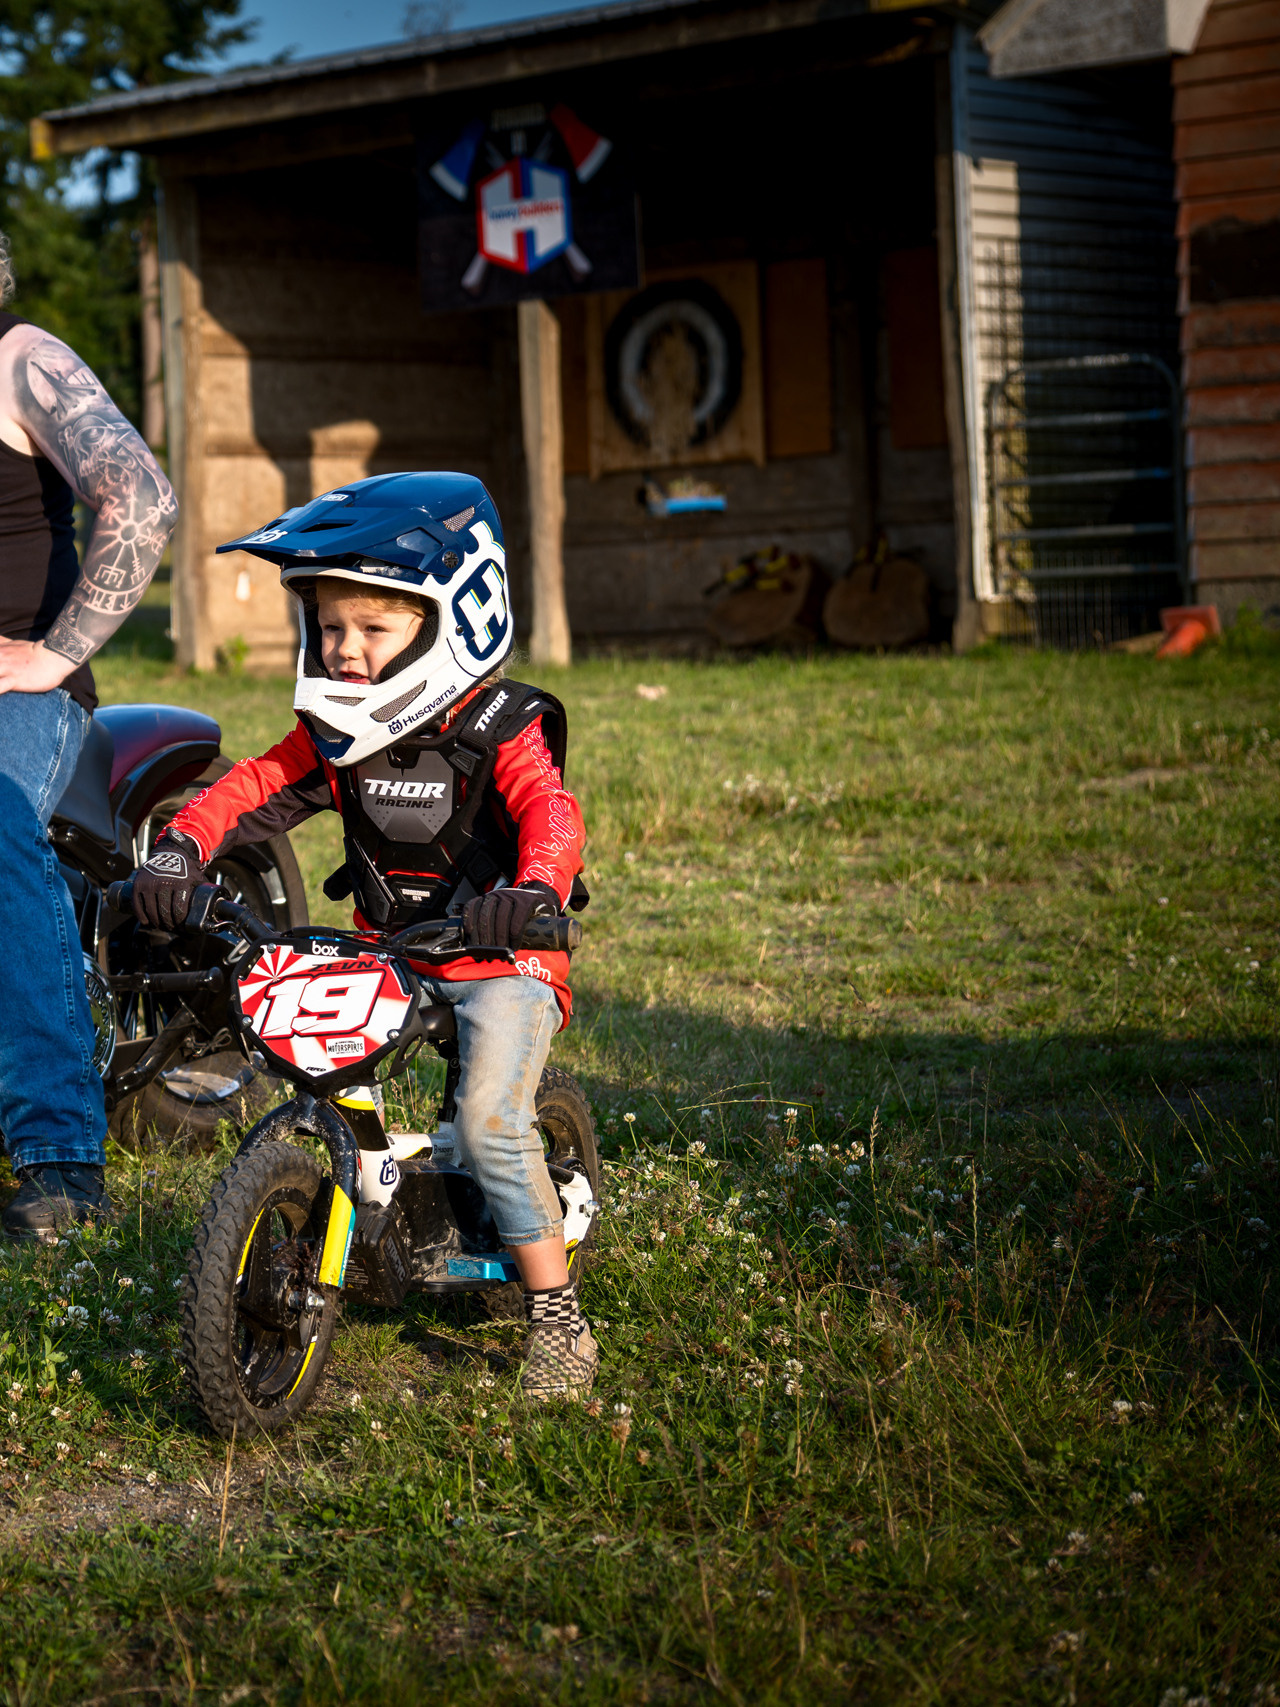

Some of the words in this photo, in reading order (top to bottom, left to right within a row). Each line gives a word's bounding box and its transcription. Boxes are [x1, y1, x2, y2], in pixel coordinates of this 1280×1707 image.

[402, 684, 457, 726] Husqvarna
[474, 690, 509, 731] THOR
[364, 778, 447, 798] THOR
[375, 798, 434, 809] RACING
[312, 940, 339, 956] box
[260, 969, 386, 1039] 19
[327, 1042, 363, 1053] MOTORSPORTS
